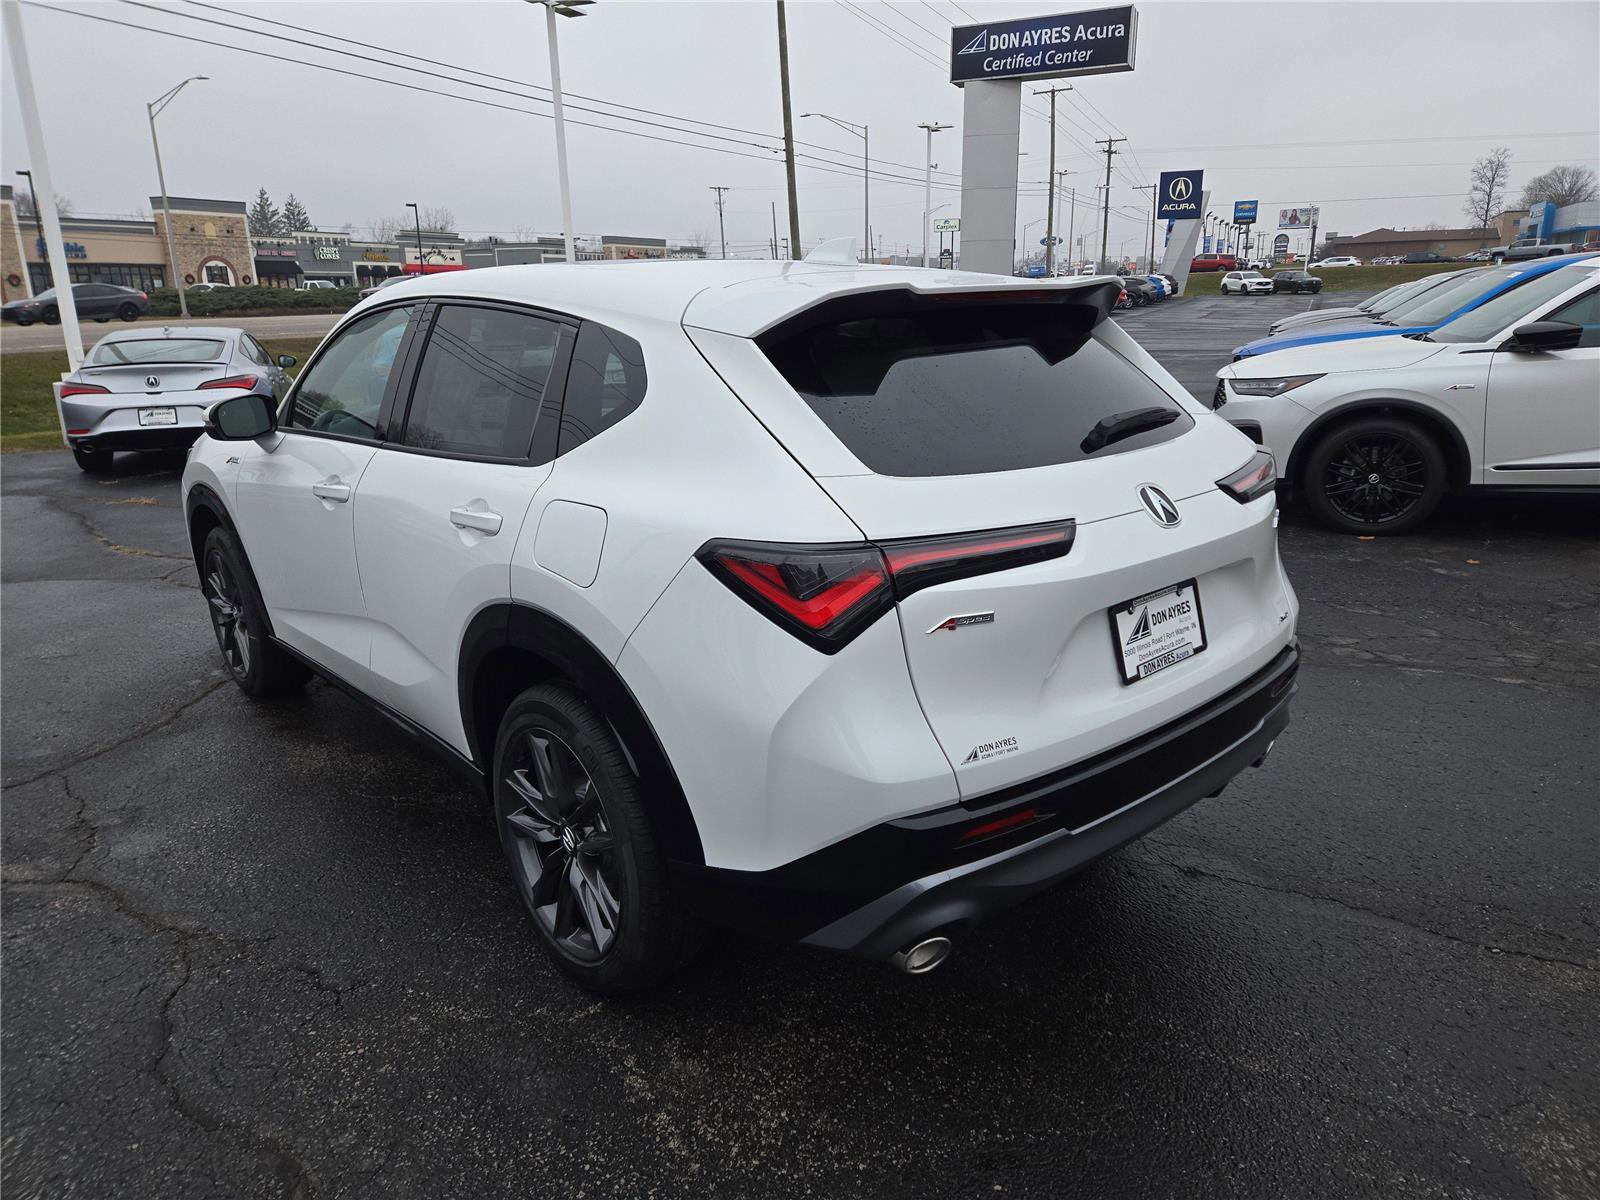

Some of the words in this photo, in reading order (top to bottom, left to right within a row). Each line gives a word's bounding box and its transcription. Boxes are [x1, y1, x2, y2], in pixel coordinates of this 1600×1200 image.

[990, 32, 1020, 51] DON
[1021, 25, 1071, 47] AYRES
[1074, 23, 1125, 42] Acura
[983, 50, 1042, 72] Certified
[1045, 49, 1093, 65] Center
[1162, 203, 1196, 211] ACURA
[319, 246, 339, 254] CRISPY
[1151, 611, 1168, 626] DON
[1168, 600, 1192, 621] AYRES
[1137, 641, 1151, 652] Illinois
[1151, 637, 1162, 648] Road
[1166, 631, 1175, 640] Fort
[1138, 637, 1186, 662] DonAyresAcura.com
[1143, 660, 1157, 675] DON
[1156, 652, 1176, 669] AYRES
[1175, 649, 1190, 660] Acura
[979, 742, 994, 753] DON
[995, 736, 1017, 749] AYRES
